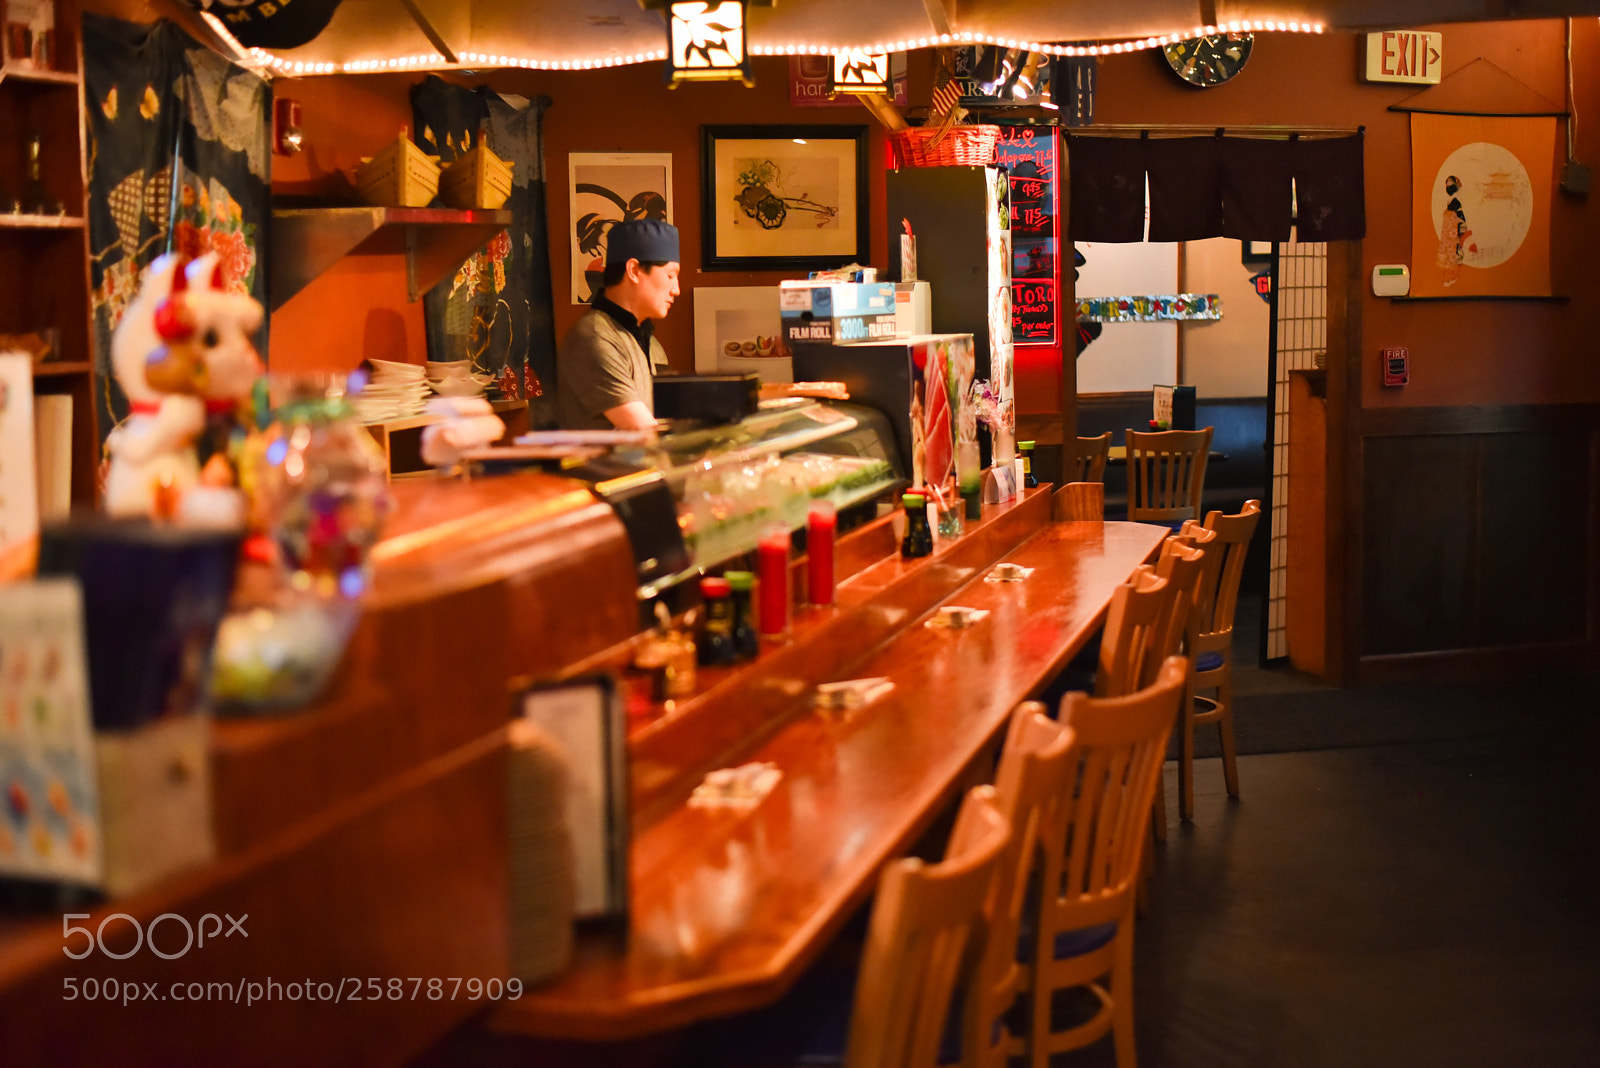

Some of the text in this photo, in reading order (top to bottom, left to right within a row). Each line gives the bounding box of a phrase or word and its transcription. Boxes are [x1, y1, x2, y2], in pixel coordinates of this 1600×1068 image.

[1381, 32, 1431, 77] EXIT
[789, 326, 832, 340] FILM ROLL
[868, 322, 882, 337] FILM
[882, 321, 896, 337] ROLL
[1387, 350, 1406, 358] FIRE
